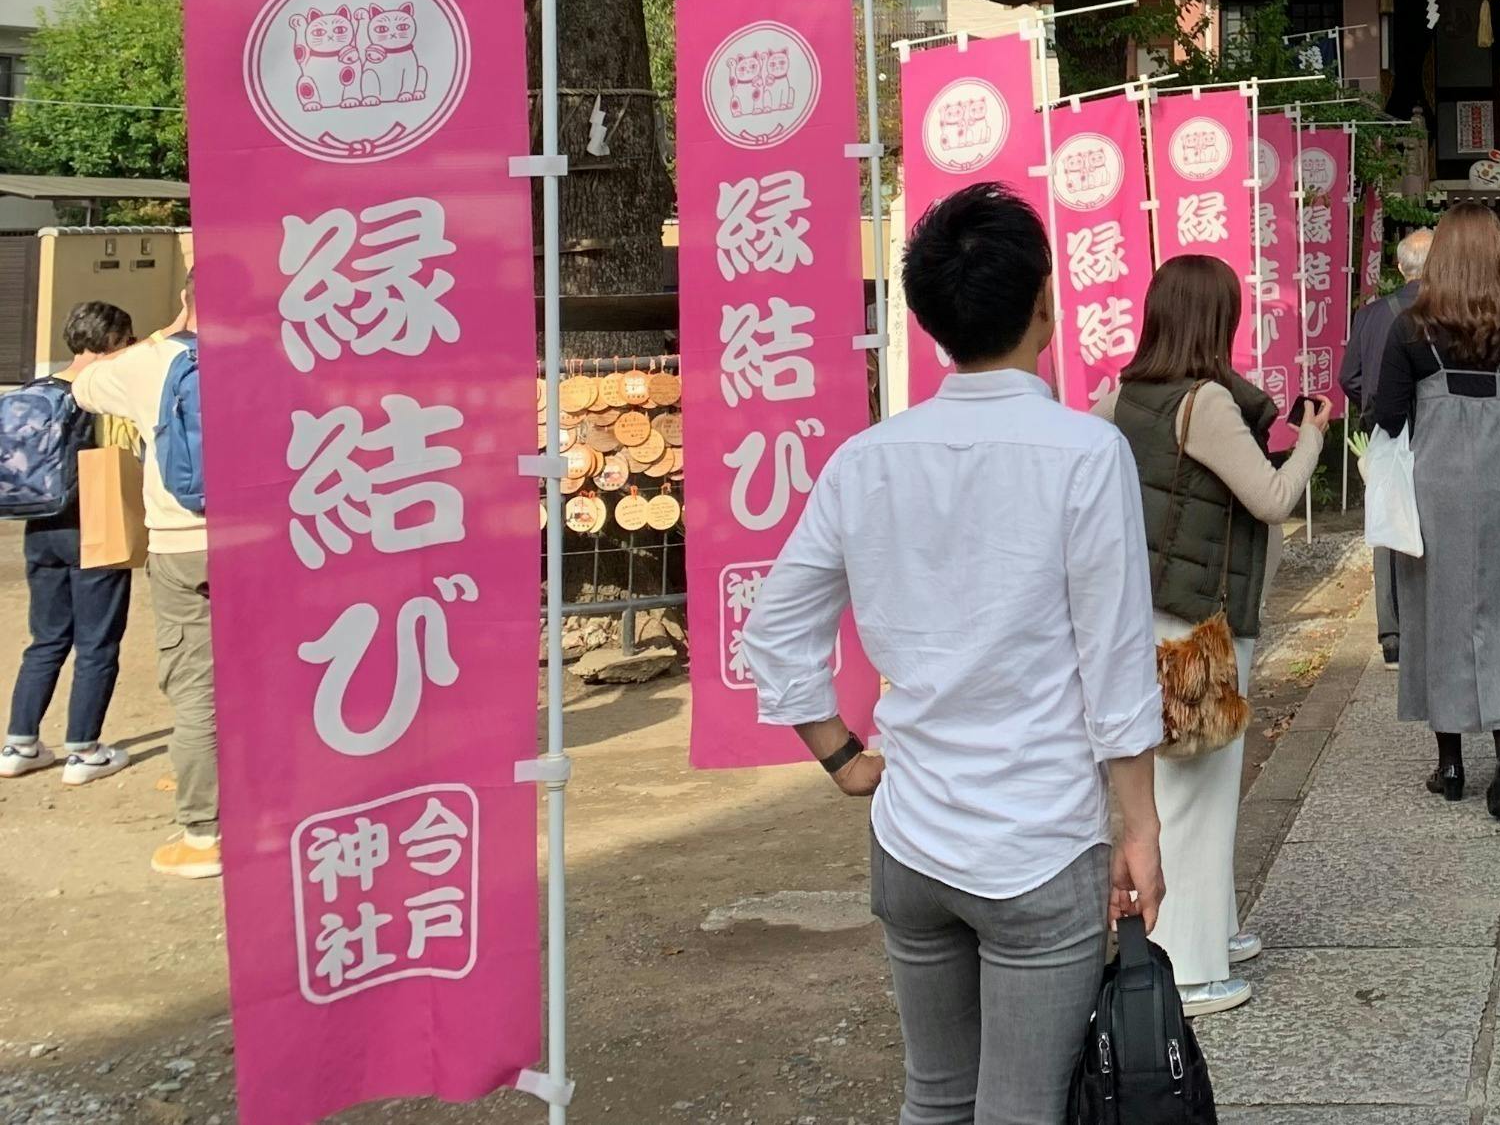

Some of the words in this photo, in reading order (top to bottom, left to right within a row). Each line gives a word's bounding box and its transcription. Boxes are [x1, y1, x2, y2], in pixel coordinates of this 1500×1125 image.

[716, 170, 825, 531] 縁結び
[1066, 221, 1137, 401] 縁結
[278, 197, 479, 756] 縁結び
[305, 817, 397, 988] 神社
[398, 797, 468, 959] 今戸
